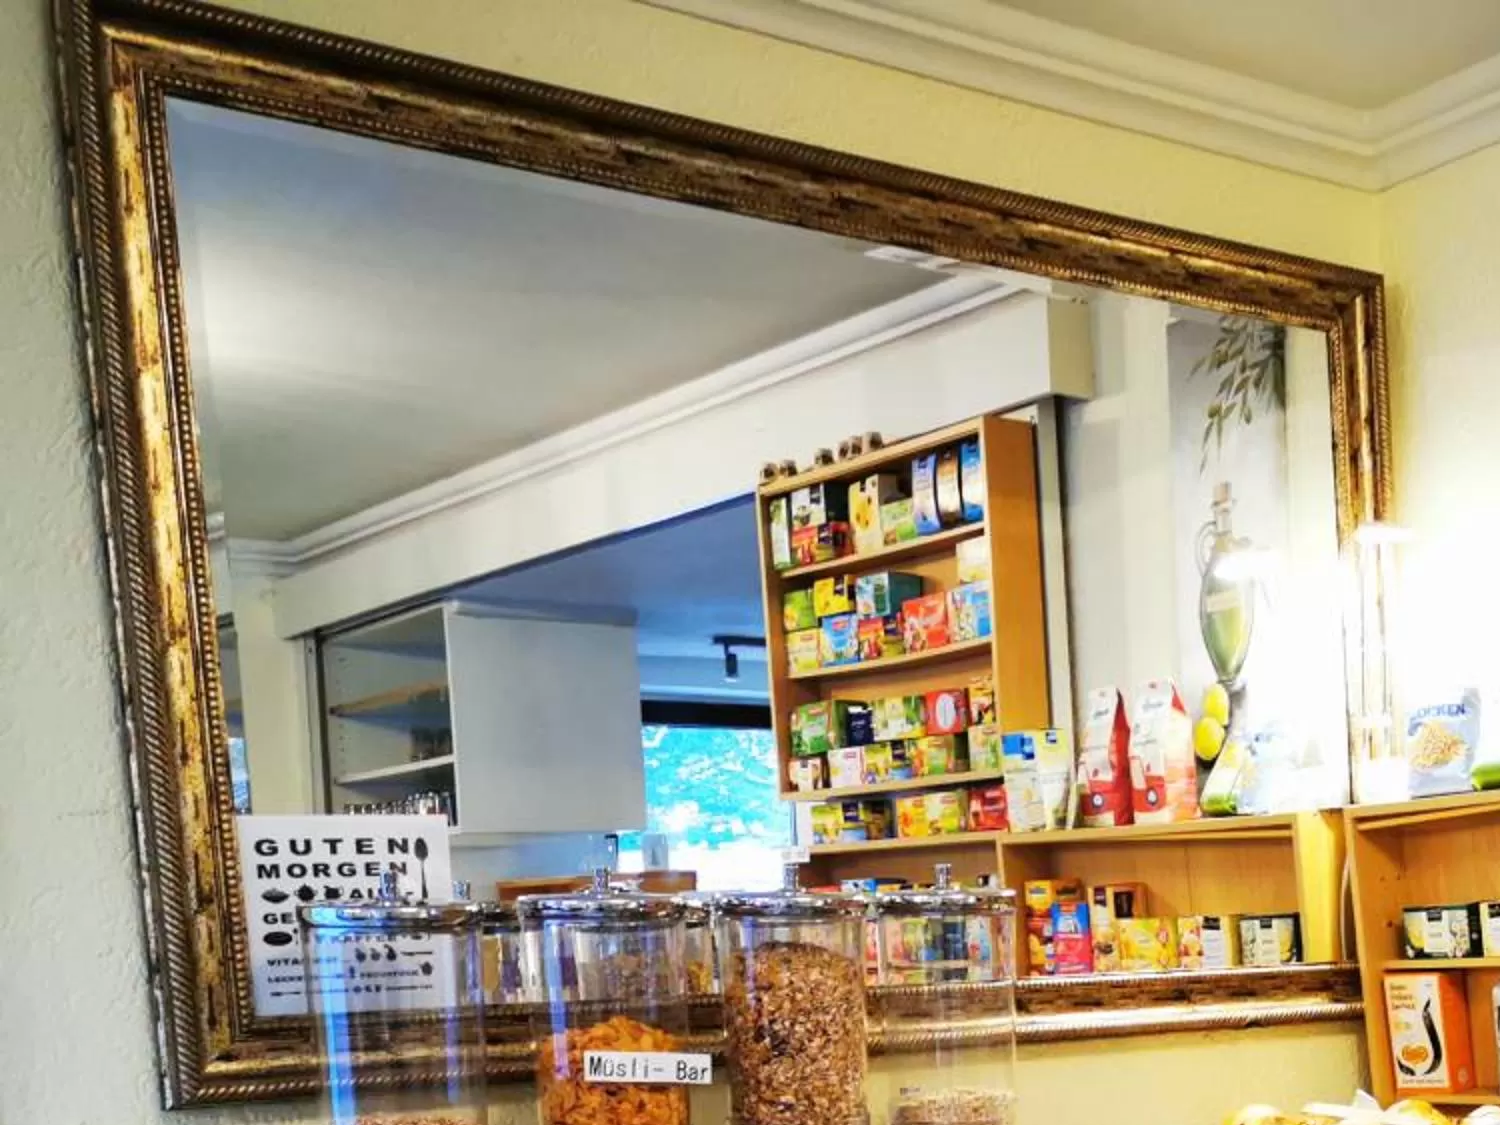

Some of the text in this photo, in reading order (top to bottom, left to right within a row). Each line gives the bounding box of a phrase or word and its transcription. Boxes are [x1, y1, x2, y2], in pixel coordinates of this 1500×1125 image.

[254, 838, 410, 857] GUTEN
[256, 861, 408, 880] MORGEN
[675, 1059, 709, 1081] Bar
